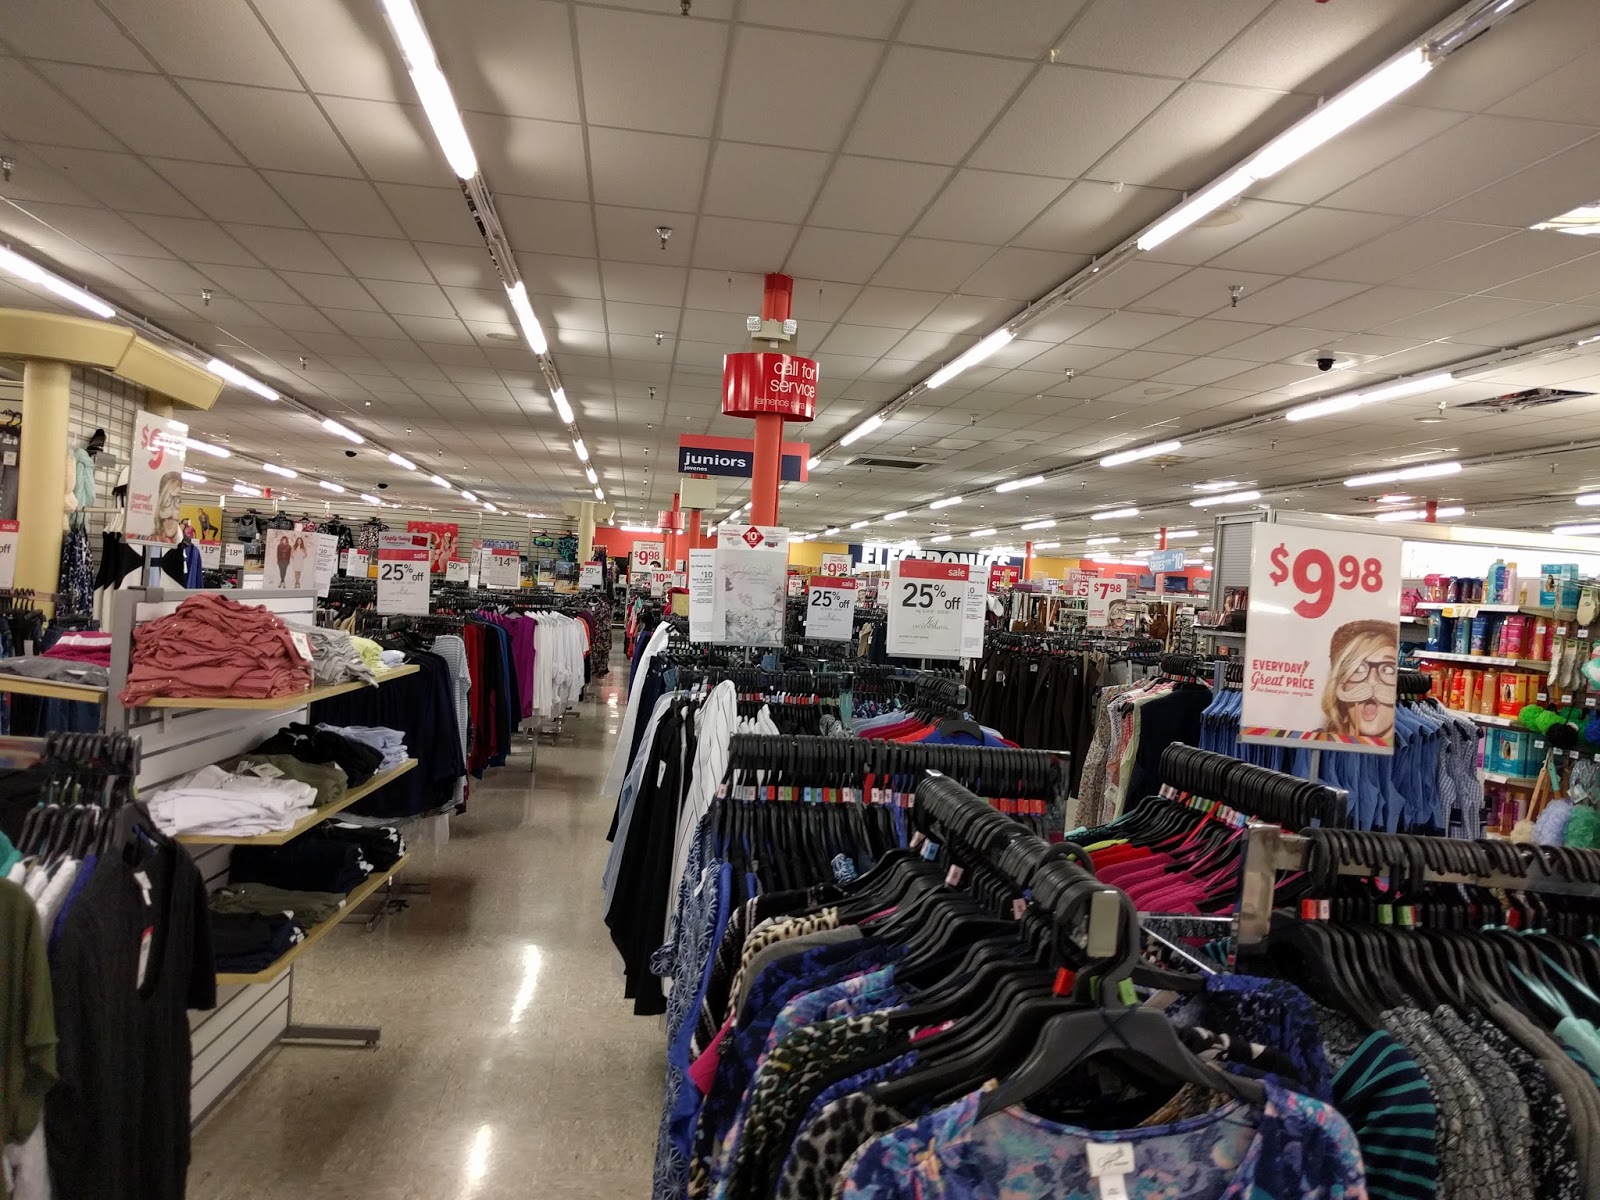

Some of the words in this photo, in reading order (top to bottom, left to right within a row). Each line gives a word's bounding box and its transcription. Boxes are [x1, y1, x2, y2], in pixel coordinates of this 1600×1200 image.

[773, 361, 799, 376] call
[802, 362, 815, 380] for
[770, 379, 815, 398] service
[684, 452, 746, 468] juniors
[381, 563, 413, 581] 25%
[412, 572, 424, 581] off
[948, 567, 966, 577] sale
[811, 590, 841, 607] 25%
[838, 600, 850, 608] off
[902, 582, 947, 608] 25%
[944, 597, 961, 610] off
[1250, 671, 1285, 690] Great
[1285, 677, 1315, 689] PRICE
